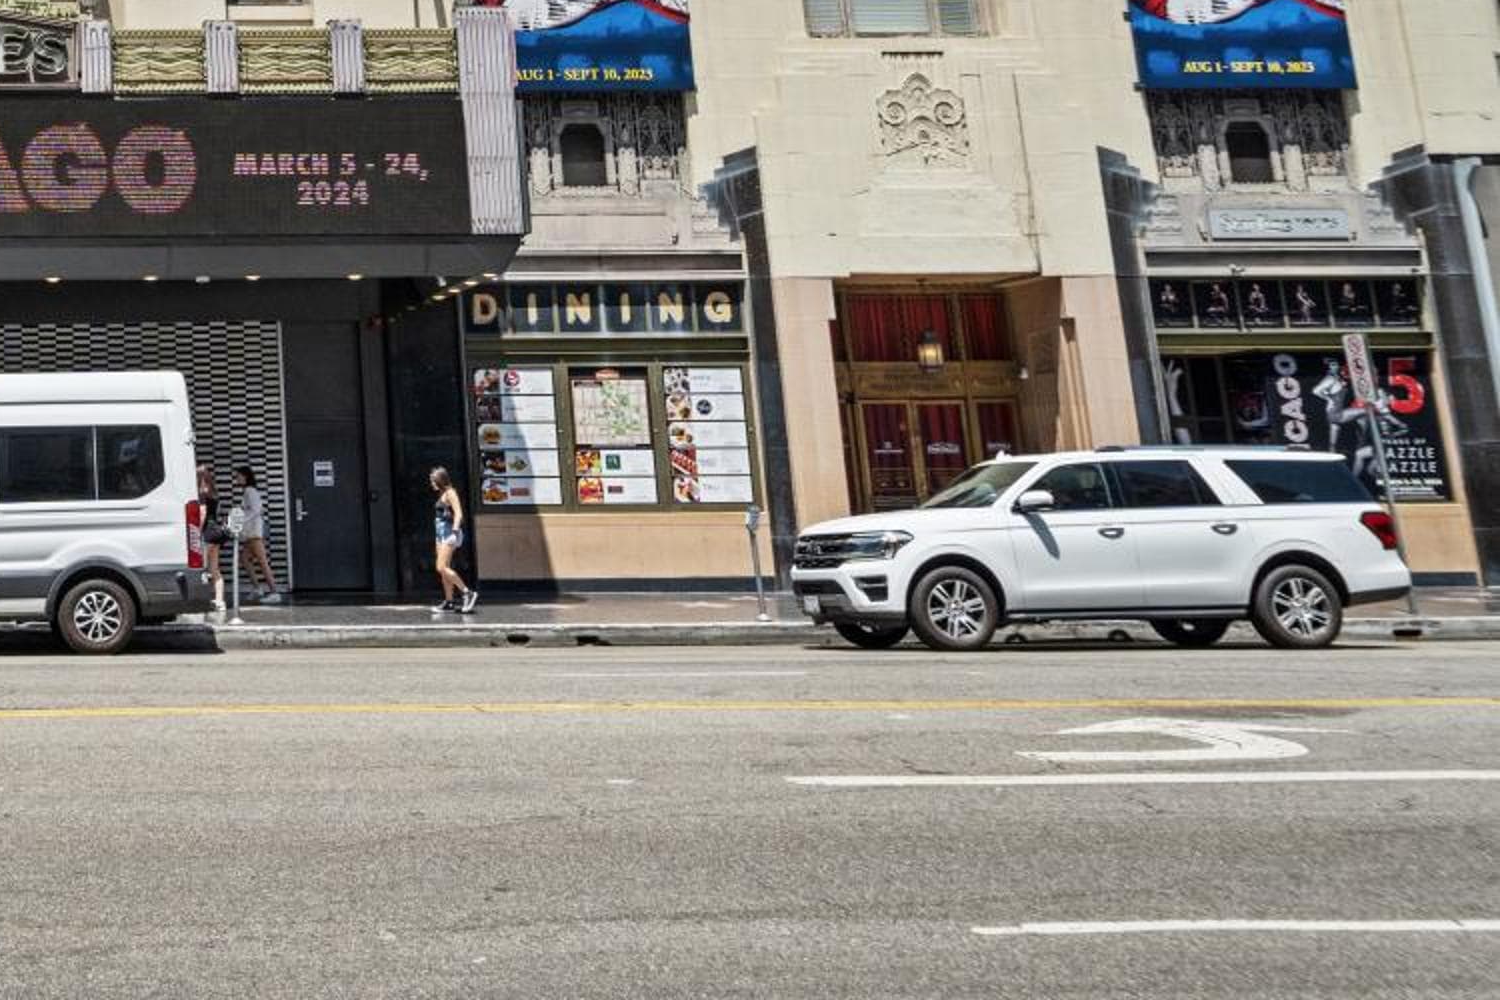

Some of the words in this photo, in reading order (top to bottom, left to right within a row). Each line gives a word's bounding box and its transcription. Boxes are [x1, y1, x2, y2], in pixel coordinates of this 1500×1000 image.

[1183, 61, 1213, 73] AUG
[1216, 61, 1222, 73] 1
[1231, 61, 1264, 73] SEPT
[515, 68, 544, 81] AUG
[547, 69, 553, 81] 1
[563, 68, 600, 81] SEPT
[604, 69, 621, 82] 10,
[624, 68, 653, 81] 2023
[233, 153, 330, 175] MARCH
[339, 153, 357, 175] 5
[384, 153, 429, 181] 24,
[296, 181, 370, 205] 2024
[472, 290, 733, 325] DINING
[1381, 447, 1436, 459] AZZLE
[1381, 461, 1437, 473] AZZLE
